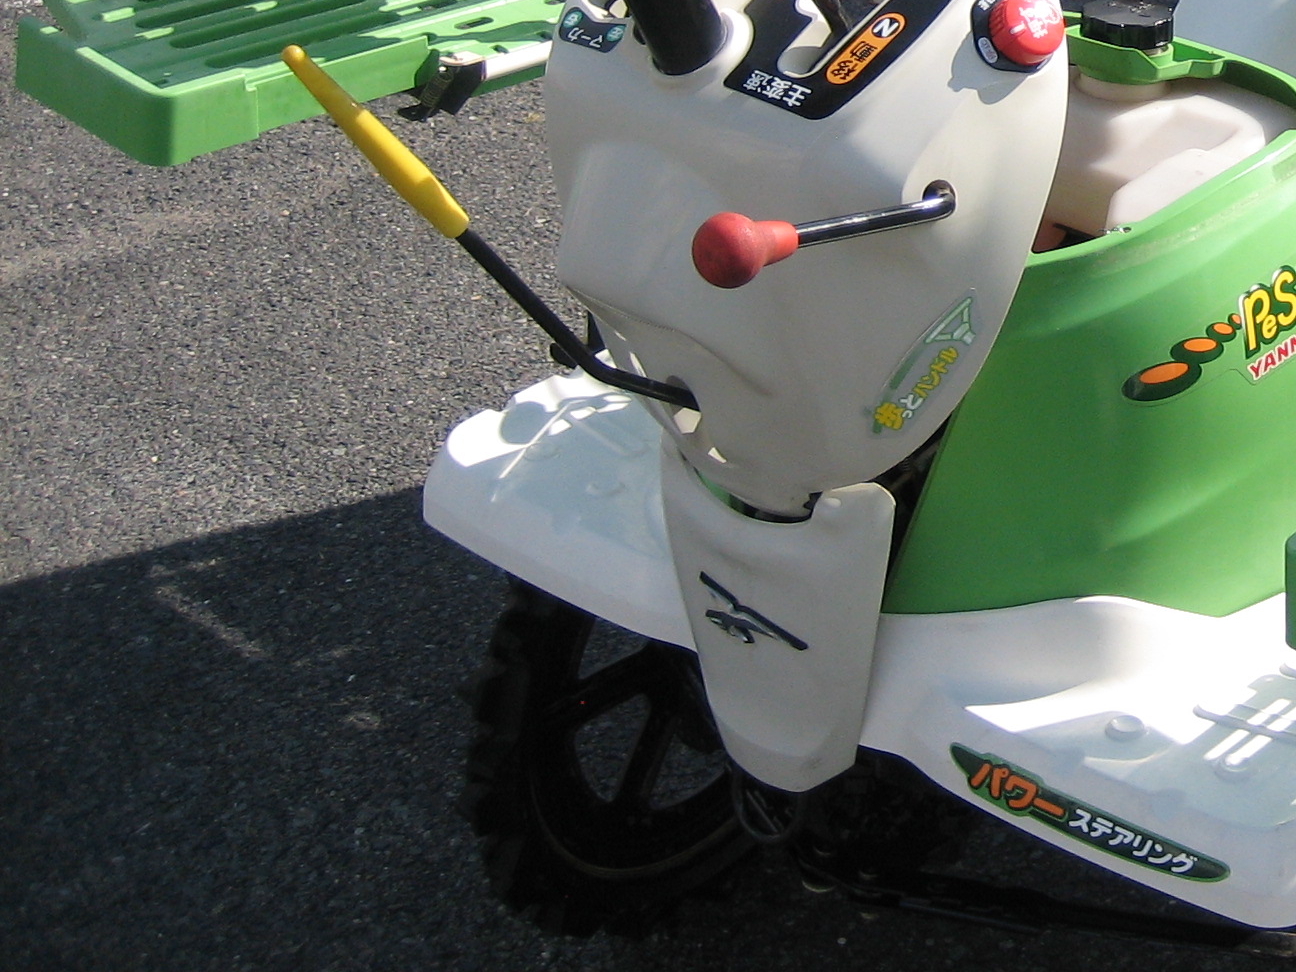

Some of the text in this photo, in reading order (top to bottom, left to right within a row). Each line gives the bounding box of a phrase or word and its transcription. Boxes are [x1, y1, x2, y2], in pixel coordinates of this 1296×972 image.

[873, 18, 899, 37] N
[830, 40, 878, 80] 移動
[743, 70, 811, 107] 主変速
